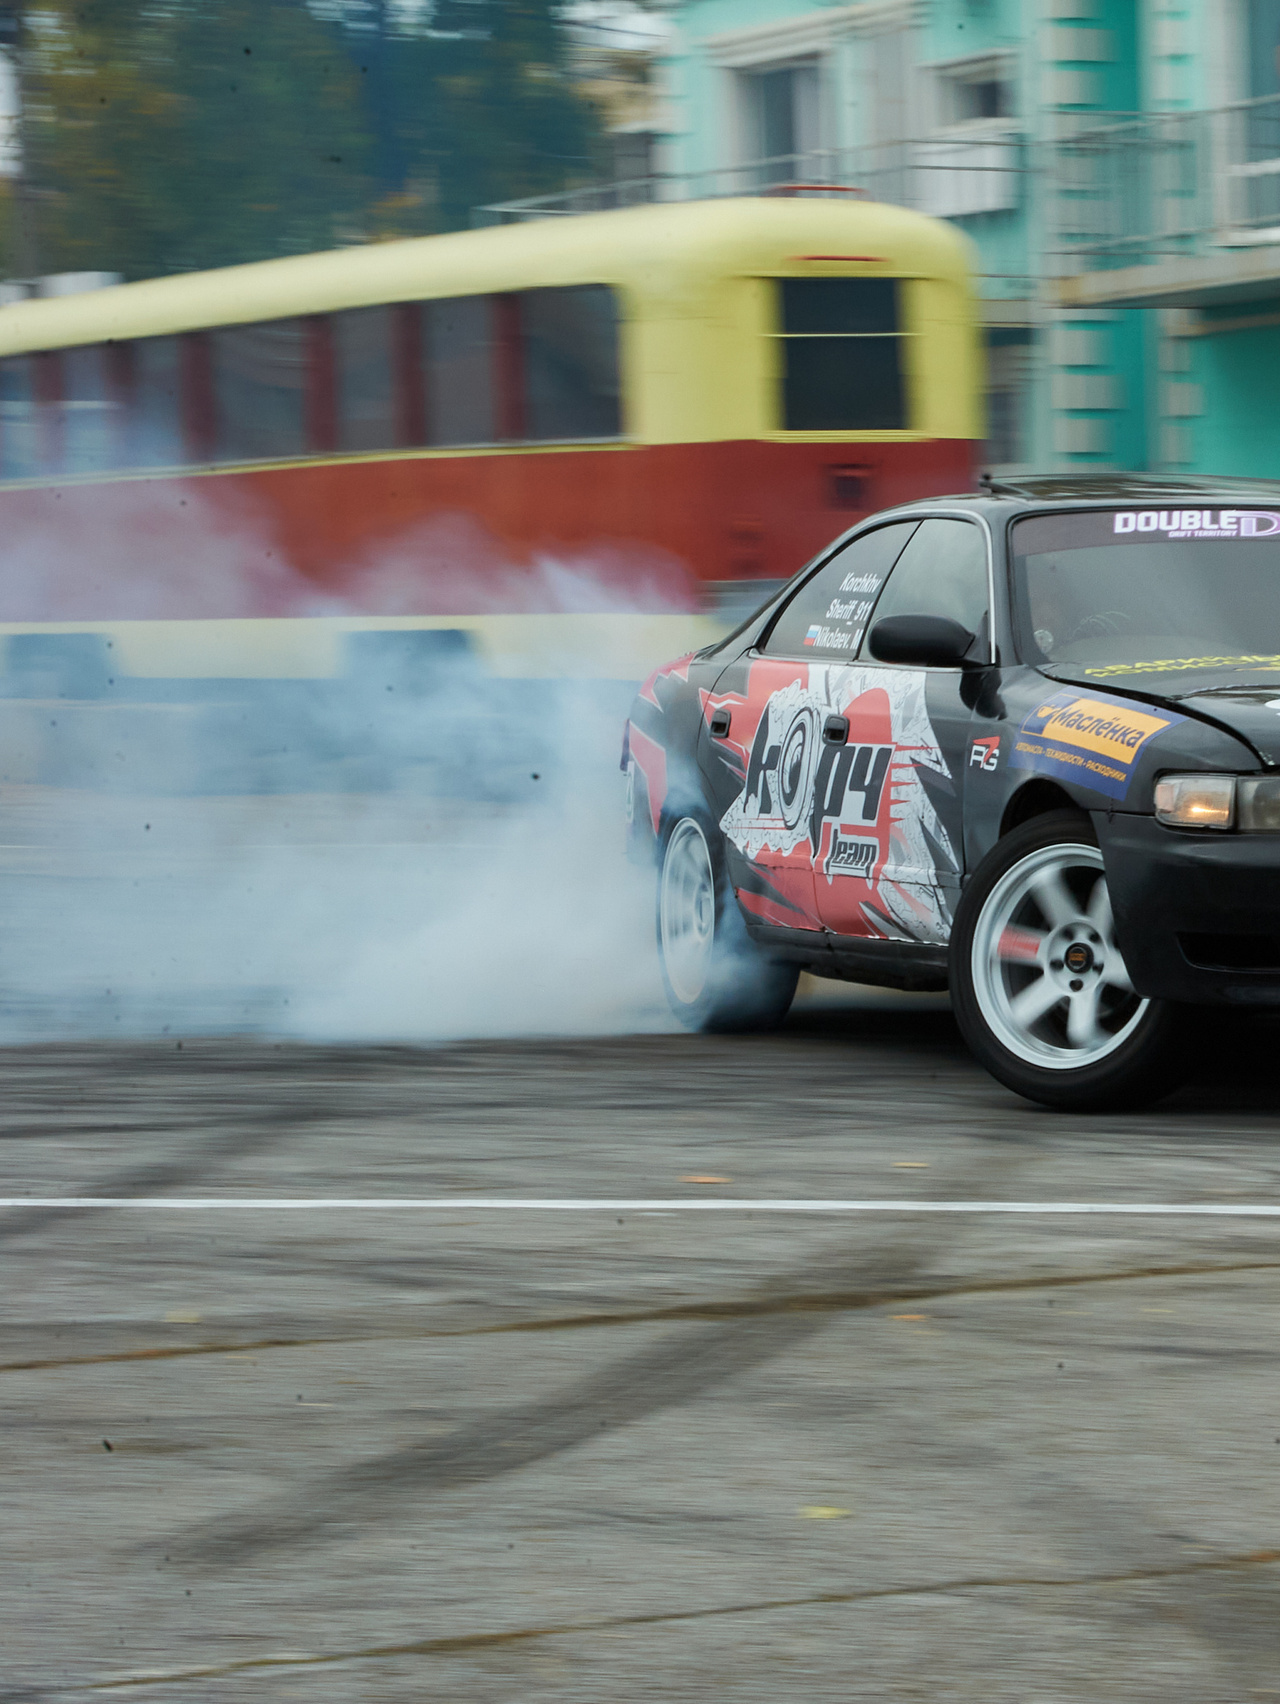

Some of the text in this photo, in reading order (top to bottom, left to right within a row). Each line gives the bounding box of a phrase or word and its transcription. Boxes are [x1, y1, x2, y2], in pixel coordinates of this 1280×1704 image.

[1113, 511, 1238, 533] DOUBLE
[1193, 529, 1239, 538] TERRITORY
[1051, 708, 1146, 749] Маслёнка
